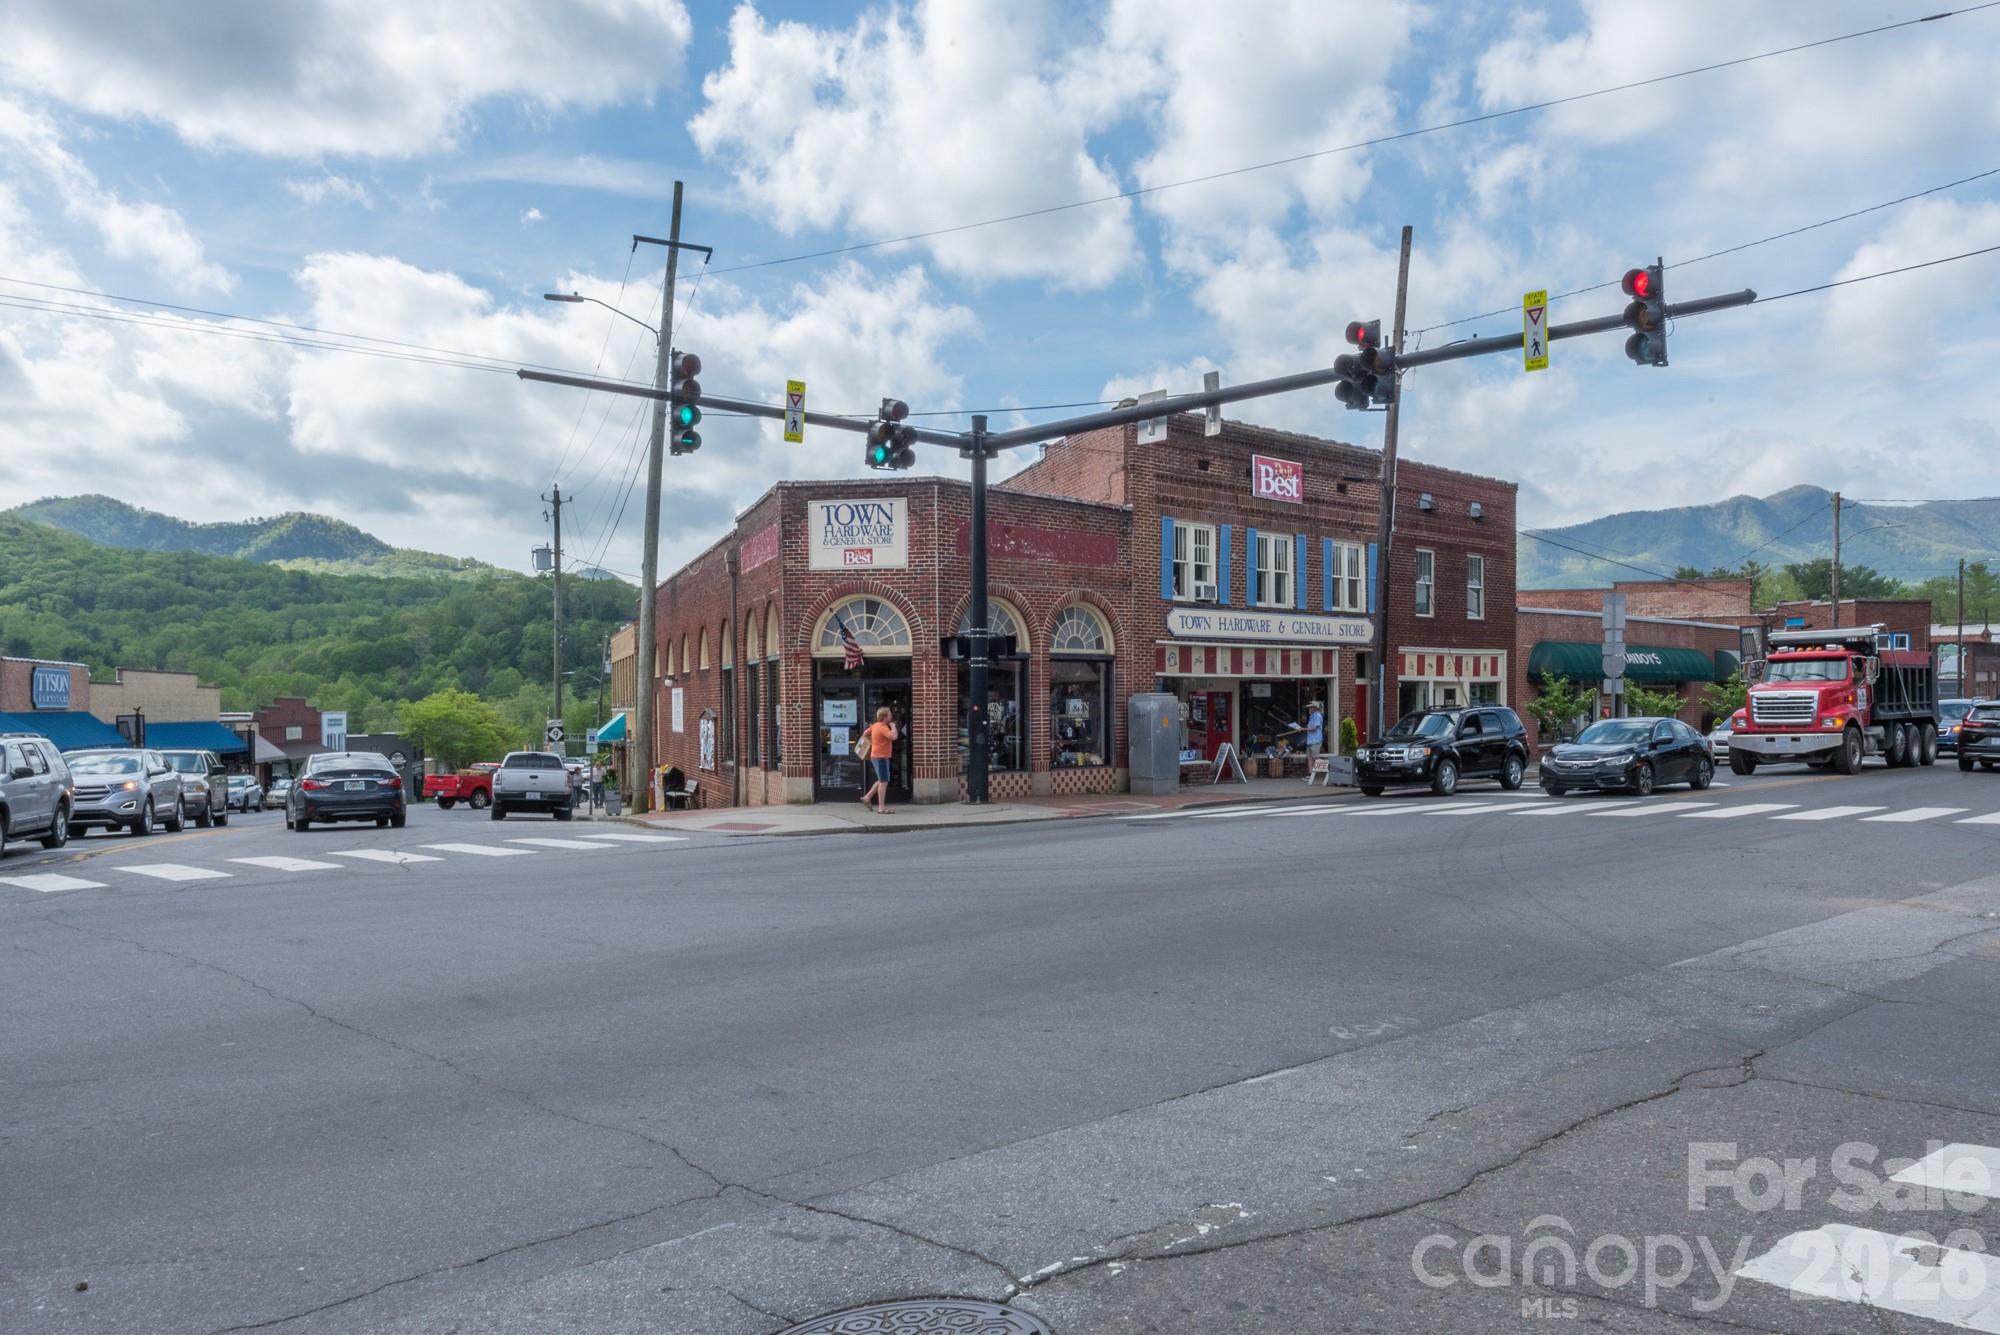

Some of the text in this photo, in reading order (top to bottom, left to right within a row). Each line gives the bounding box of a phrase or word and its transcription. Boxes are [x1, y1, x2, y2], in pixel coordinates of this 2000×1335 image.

[1258, 464, 1300, 498] Best
[821, 502, 894, 526] TOWN
[824, 524, 894, 538] HARDWARE
[829, 537, 866, 546] GENERAL
[867, 535, 893, 545] STORE
[845, 551, 871, 564] Best
[1179, 615, 1366, 637] TOWN HARDWARE & GENERAL STORE
[37, 672, 70, 692] TYSON
[552, 730, 559, 739] 9
